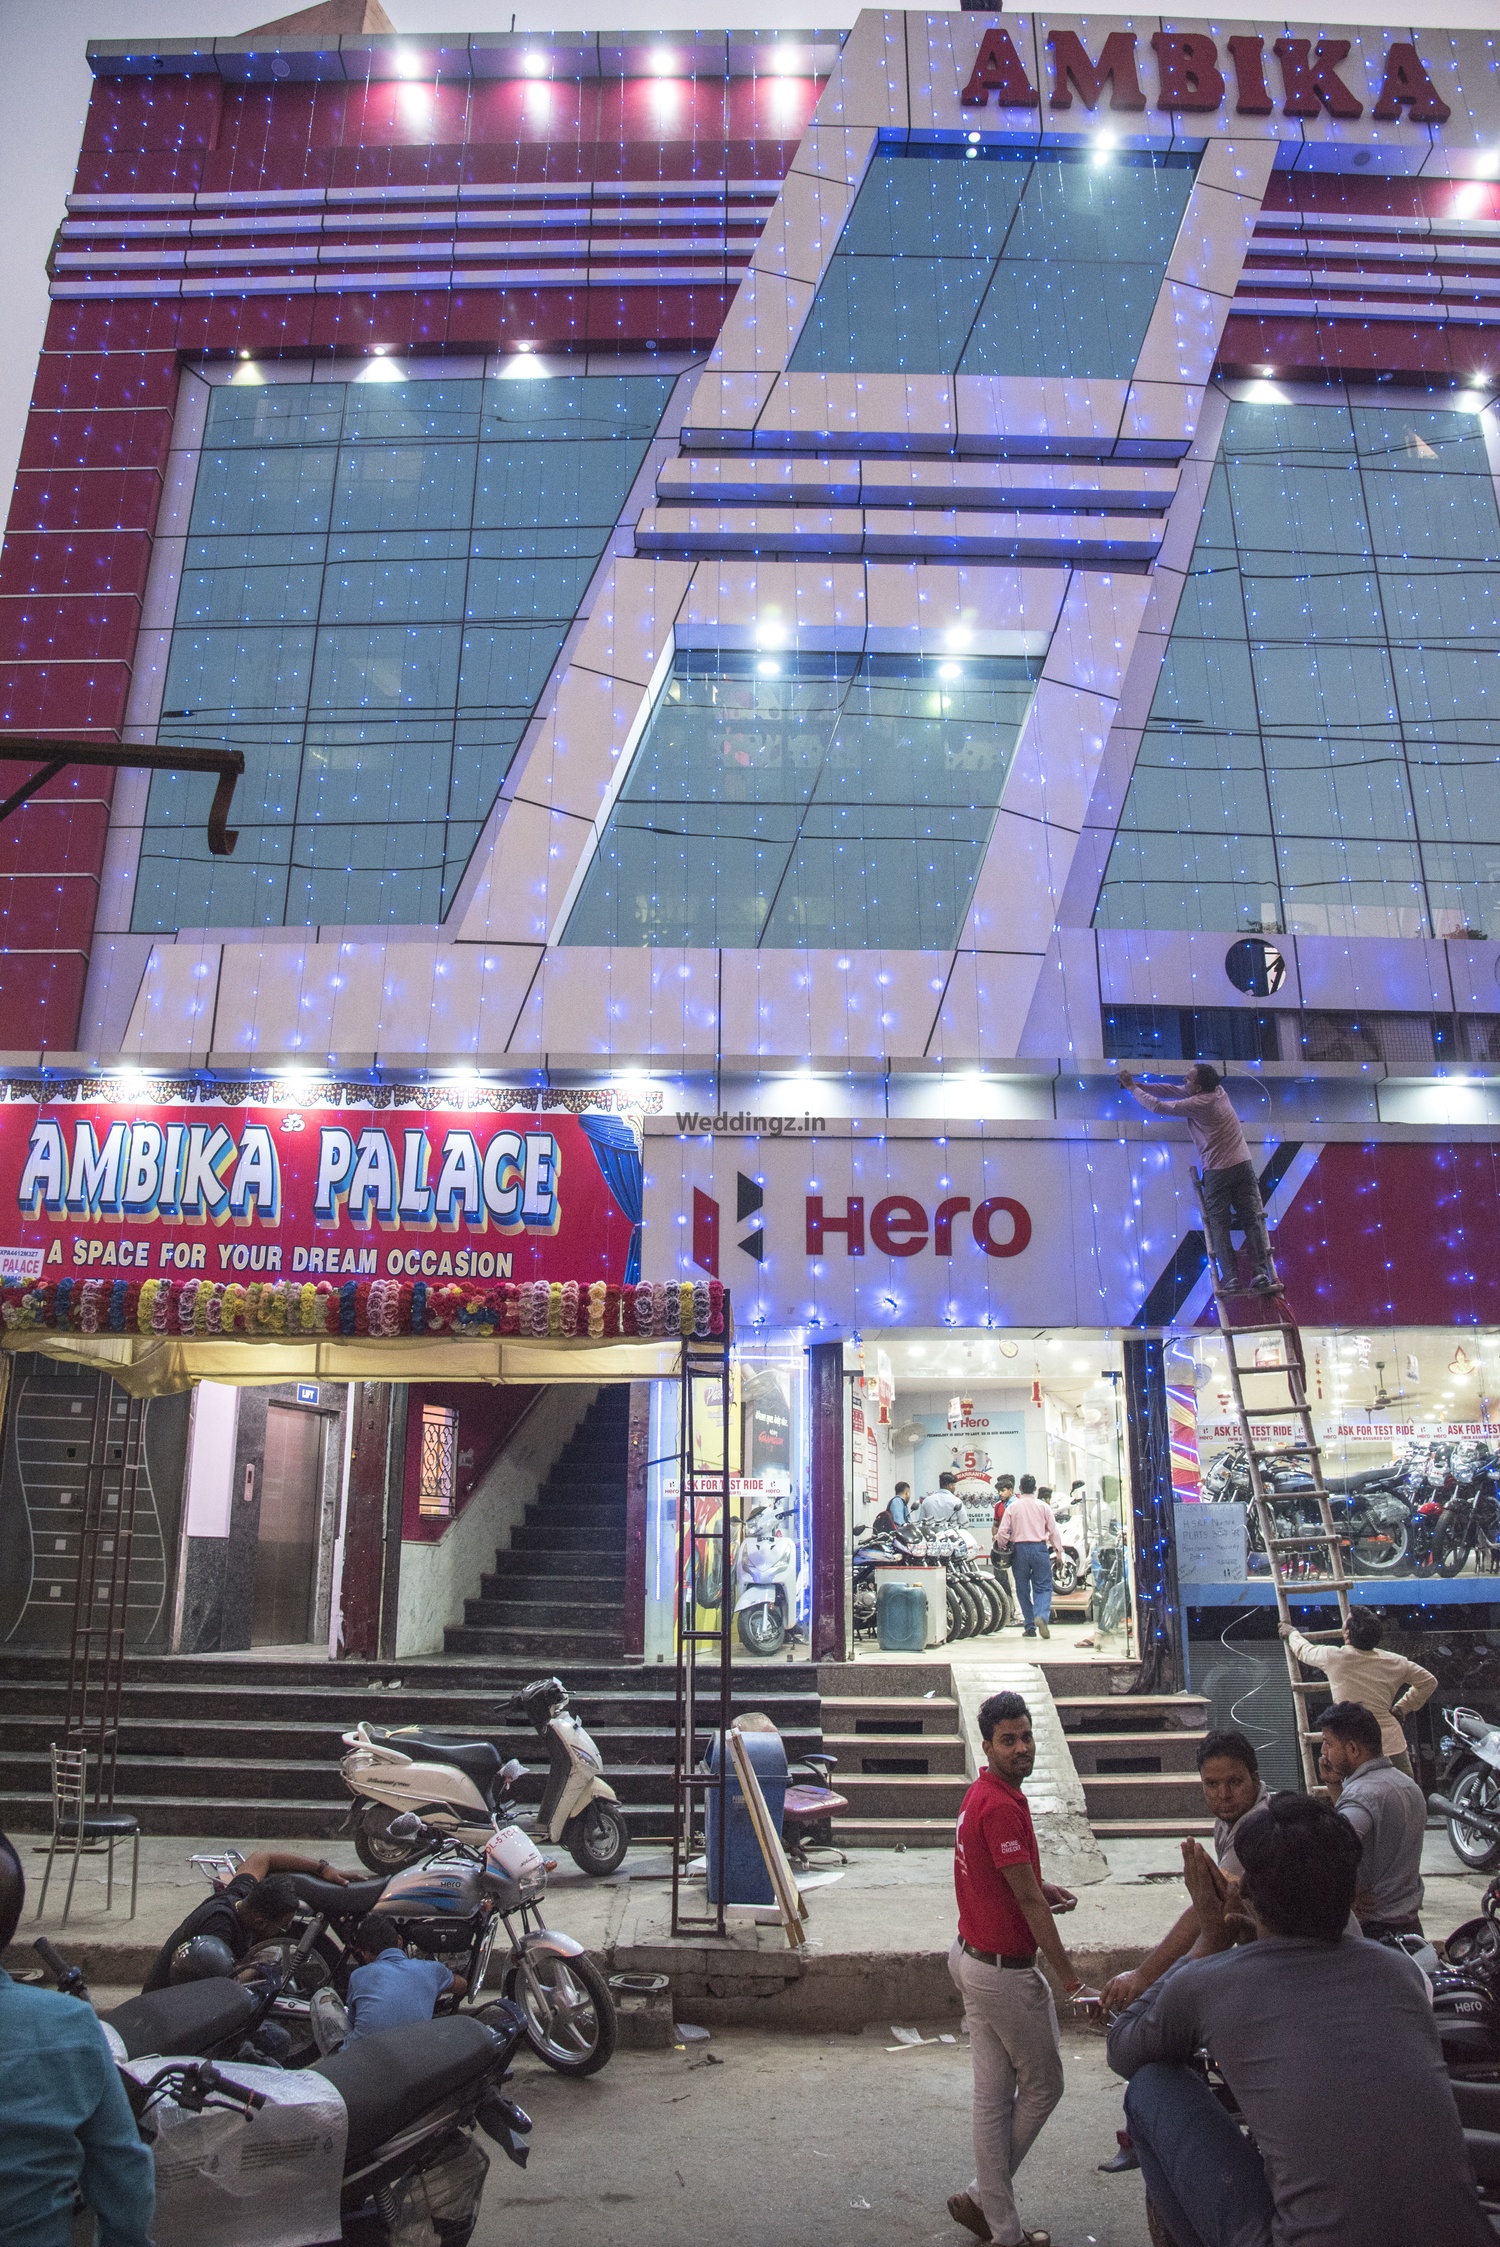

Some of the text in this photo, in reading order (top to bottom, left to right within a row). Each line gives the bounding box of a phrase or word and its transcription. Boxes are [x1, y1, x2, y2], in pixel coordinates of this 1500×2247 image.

[961, 28, 1451, 123] AMBIKA
[19, 1119, 561, 1236] AMBIKA PALACE
[806, 1196, 1032, 1257] Hero
[47, 1239, 513, 1278] A SPACE FOR YOUR DREAM OCCASION
[2, 1259, 40, 1274] PALACE
[301, 1388, 315, 1400] LIFT
[960, 1418, 990, 1428] Hero
[1214, 1426, 1292, 1436] ASK FO TEST RIDE
[1338, 1426, 1415, 1435] ASK FOR TEST RIDE
[1448, 1424, 1500, 1435] ASK FOR TEST
[964, 1452, 977, 1468] 5
[701, 1480, 718, 1490] FOR
[721, 1480, 740, 1490] TST
[743, 1480, 763, 1490] RIDE
[1000, 1840, 1018, 1848] HOME
[440, 1880, 461, 1888] Hero
[1455, 2001, 1482, 2013] Hero
